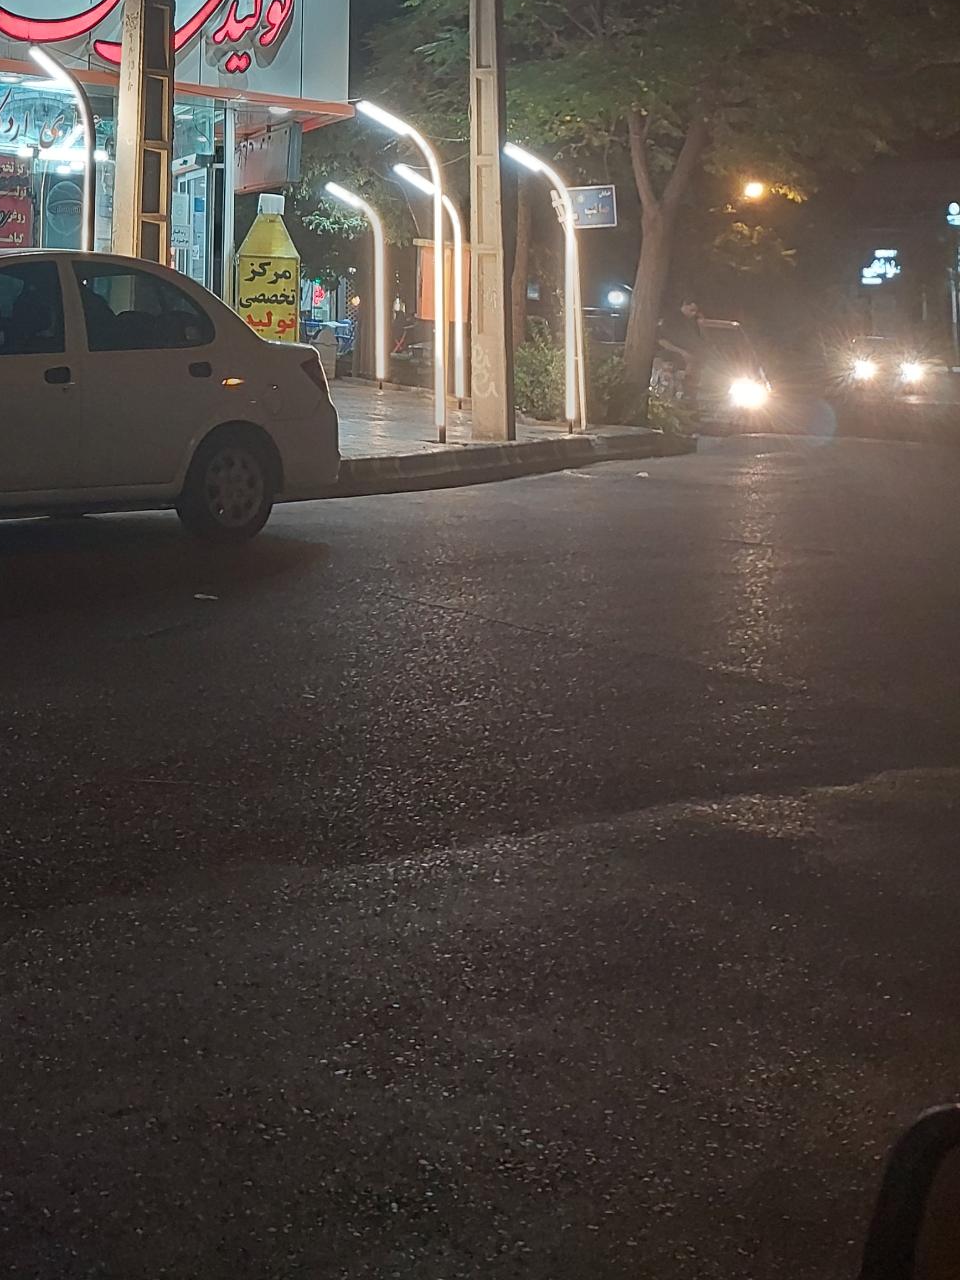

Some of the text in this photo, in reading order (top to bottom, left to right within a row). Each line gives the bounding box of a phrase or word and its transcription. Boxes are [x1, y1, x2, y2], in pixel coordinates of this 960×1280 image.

[244, 262, 291, 284] مرکز
[240, 288, 296, 308] تخصصی
[246, 310, 297, 334] تولید
